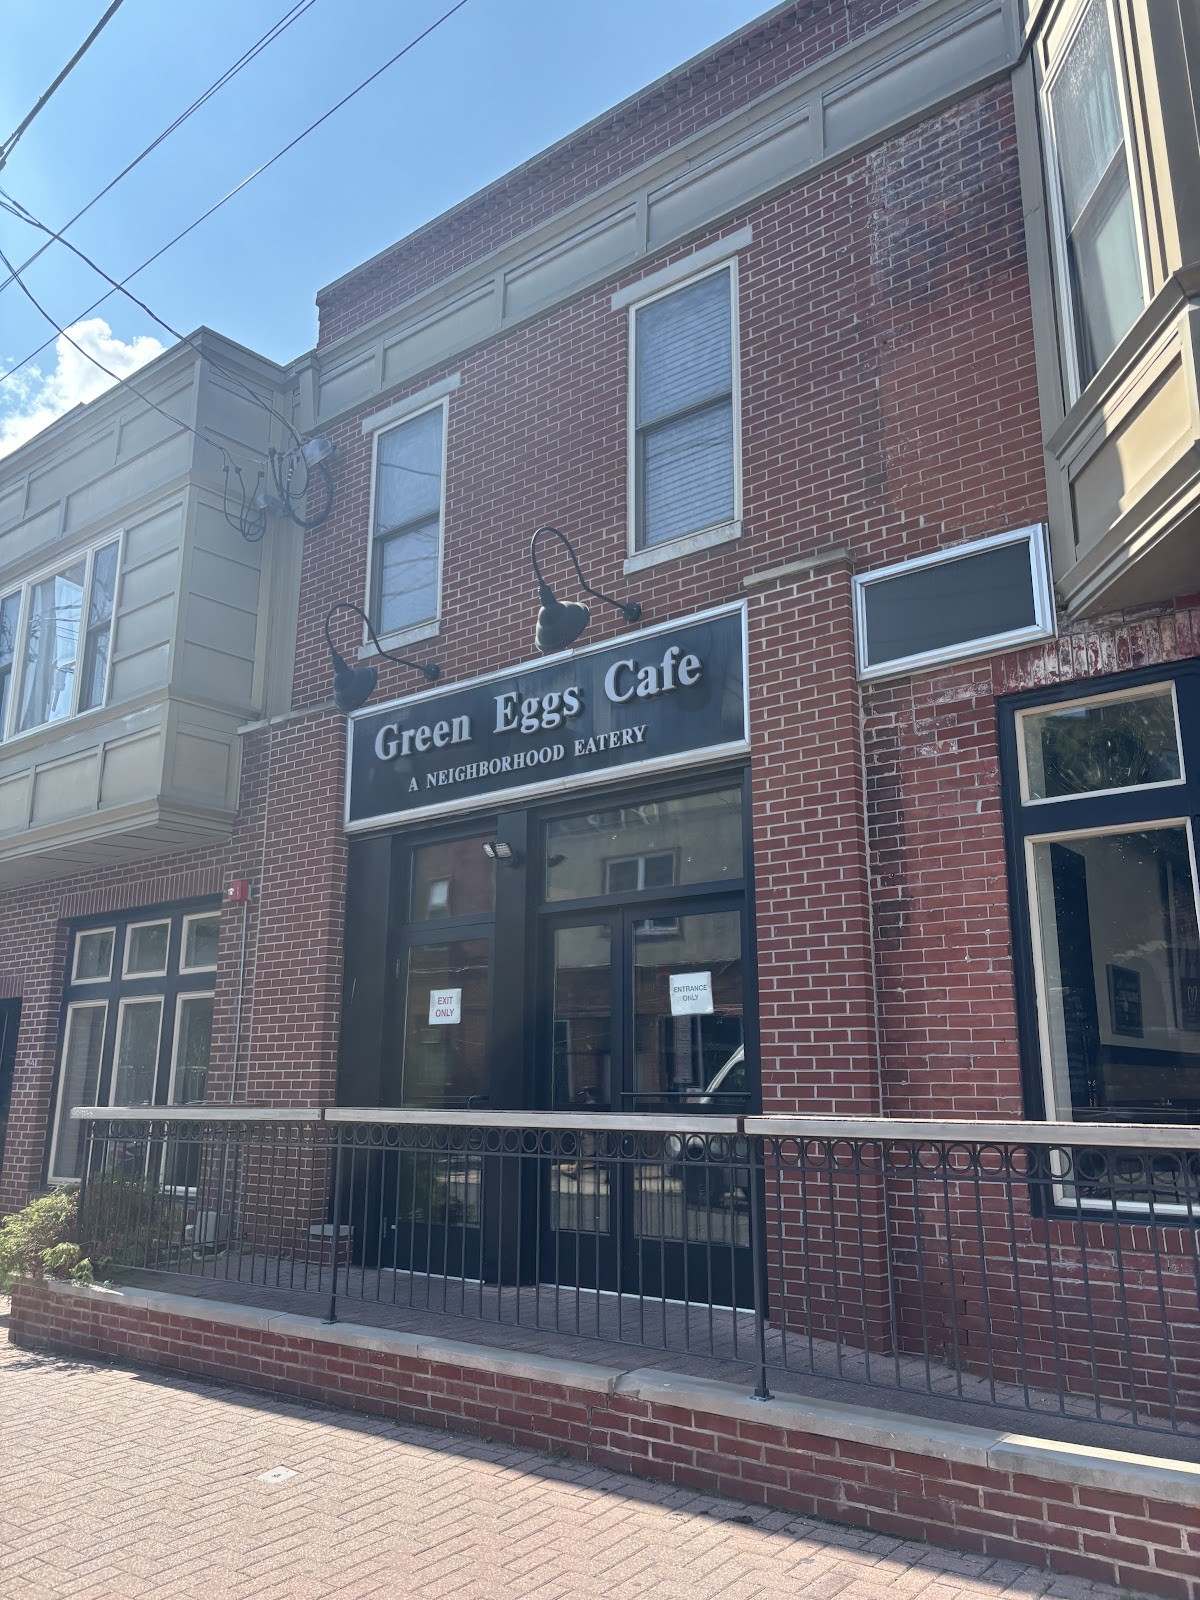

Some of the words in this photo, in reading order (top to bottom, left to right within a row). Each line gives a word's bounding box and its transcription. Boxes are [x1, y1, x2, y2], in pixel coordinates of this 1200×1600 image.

[375, 715, 472, 761] Green
[493, 686, 580, 734] Eggs
[604, 646, 702, 703] Cafe
[408, 776, 419, 793] A
[426, 743, 565, 789] NEIGHBORHOOD
[574, 724, 647, 757] EATERY
[673, 984, 708, 993] ENTRANCE
[437, 996, 453, 1005] EXIT
[682, 994, 699, 1002] ONLY
[435, 1008, 455, 1018] ONLY
